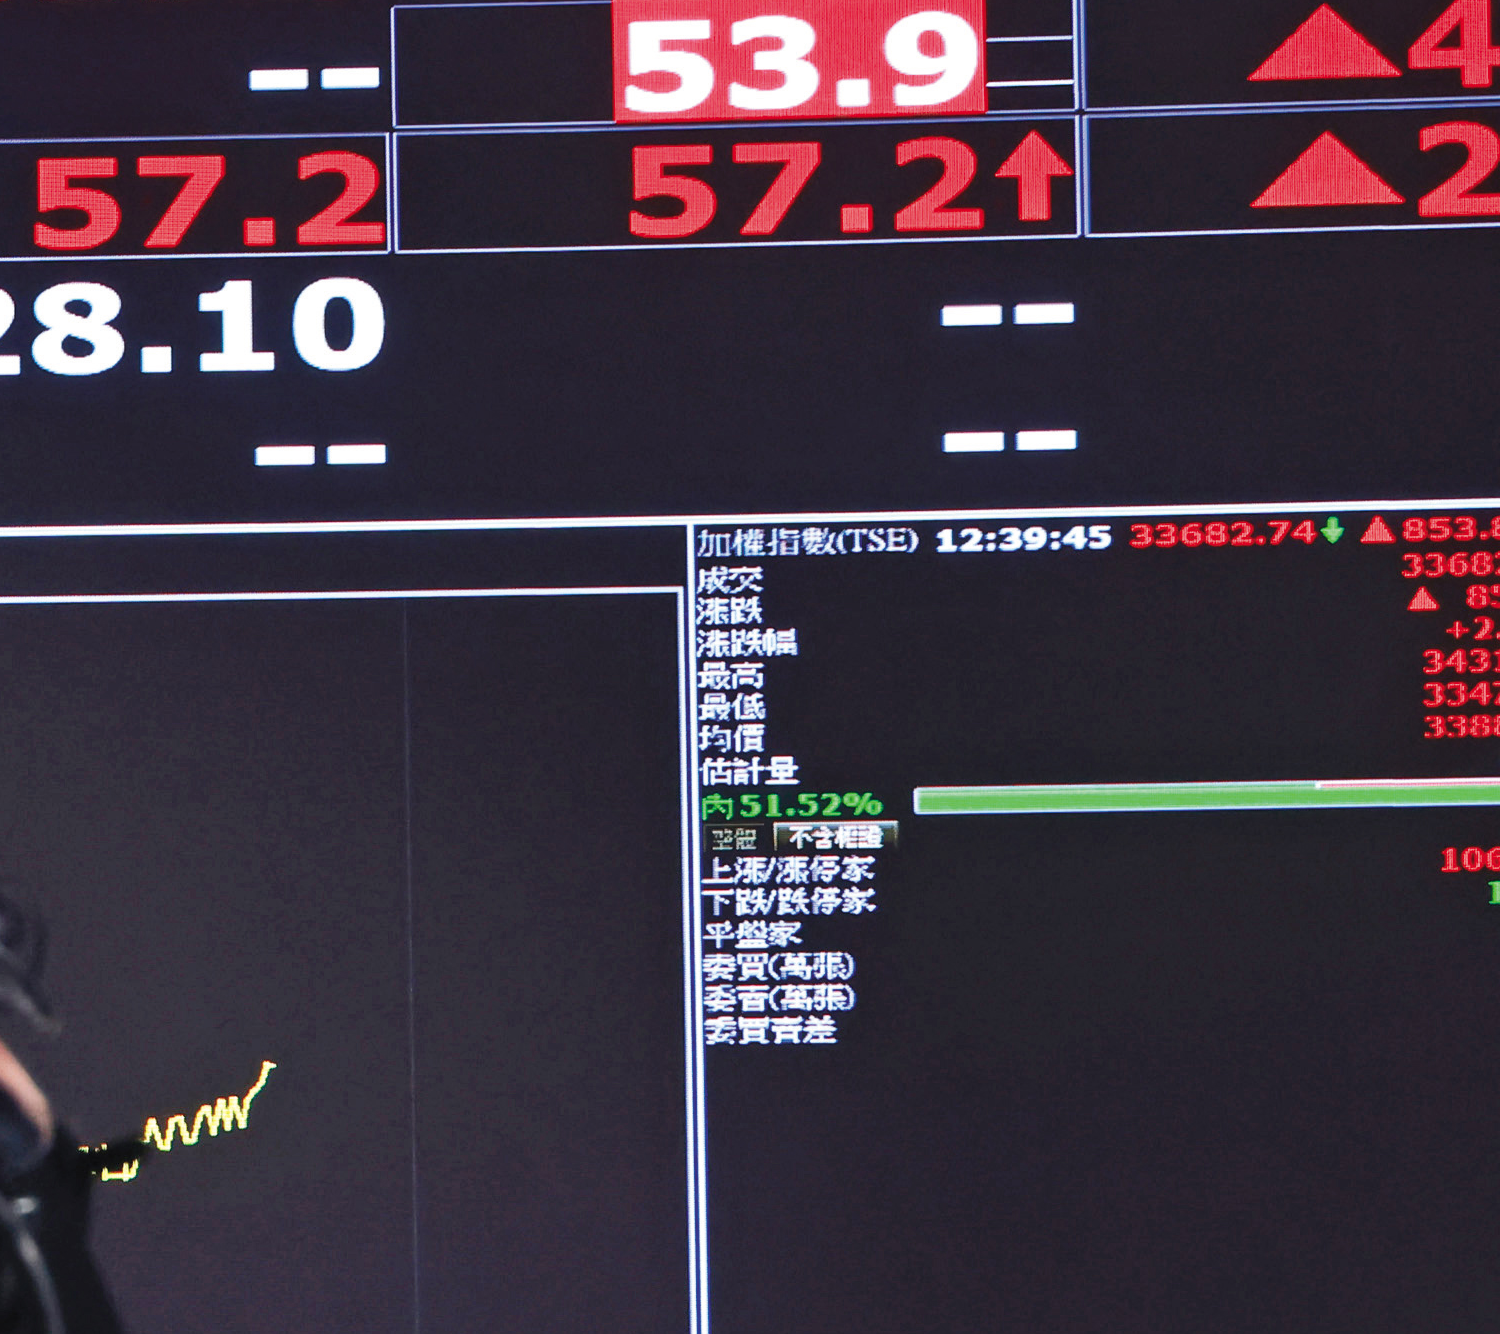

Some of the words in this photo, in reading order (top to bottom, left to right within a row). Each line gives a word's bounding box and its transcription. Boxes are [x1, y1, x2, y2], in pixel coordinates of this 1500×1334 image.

[625, 11, 978, 112] 53.9
[937, 526, 1111, 552] 12:39:45
[1130, 520, 1317, 548] 33682.74
[740, 793, 883, 817] 51.52%
